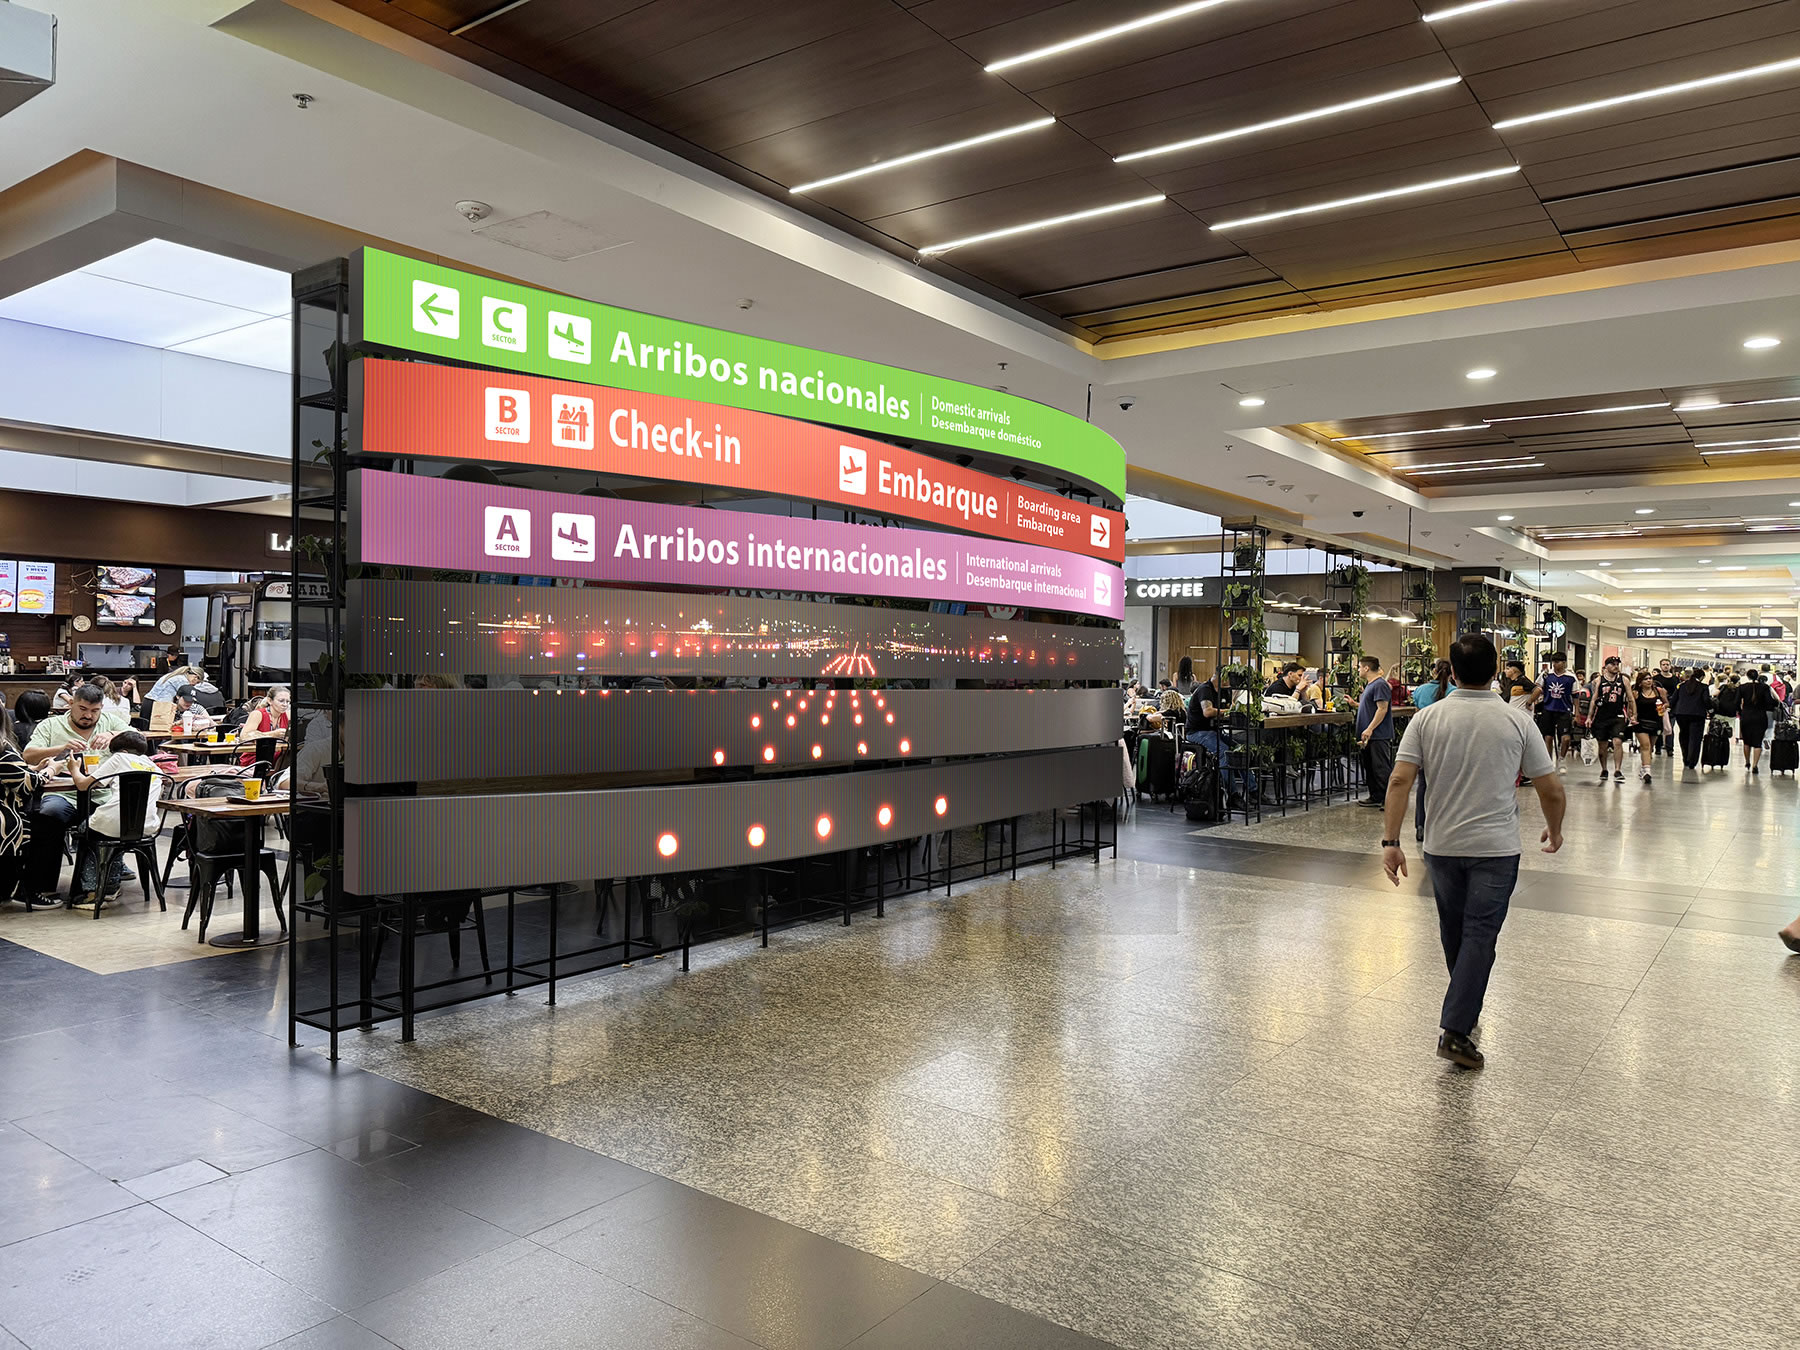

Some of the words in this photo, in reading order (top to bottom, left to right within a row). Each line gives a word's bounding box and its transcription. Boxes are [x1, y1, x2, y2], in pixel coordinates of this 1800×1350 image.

[493, 307, 512, 333] C
[491, 333, 517, 345] SECTOR
[610, 331, 748, 386] Arribos
[759, 366, 910, 420] nacionales
[499, 395, 518, 423] B
[931, 395, 976, 418] Domestic
[977, 408, 1011, 425] arrivals
[495, 426, 520, 436] SECTOR
[609, 408, 741, 464] Check-in
[931, 415, 996, 439] Desembarque
[998, 428, 1042, 449] doméstico
[878, 459, 998, 521] Embarque
[1017, 495, 1060, 521] Boarding
[1061, 511, 1081, 524] area
[496, 515, 519, 542] A
[1017, 513, 1064, 537] Embarque
[494, 543, 520, 552] SECTOR
[614, 524, 739, 566] Arribos
[748, 533, 948, 581] internacionales
[966, 552, 1028, 573] International
[1030, 562, 1062, 577] arrivals
[966, 572, 1033, 593] Desembarque
[1034, 579, 1087, 599] internacional
[1136, 582, 1204, 598] COFFEE
